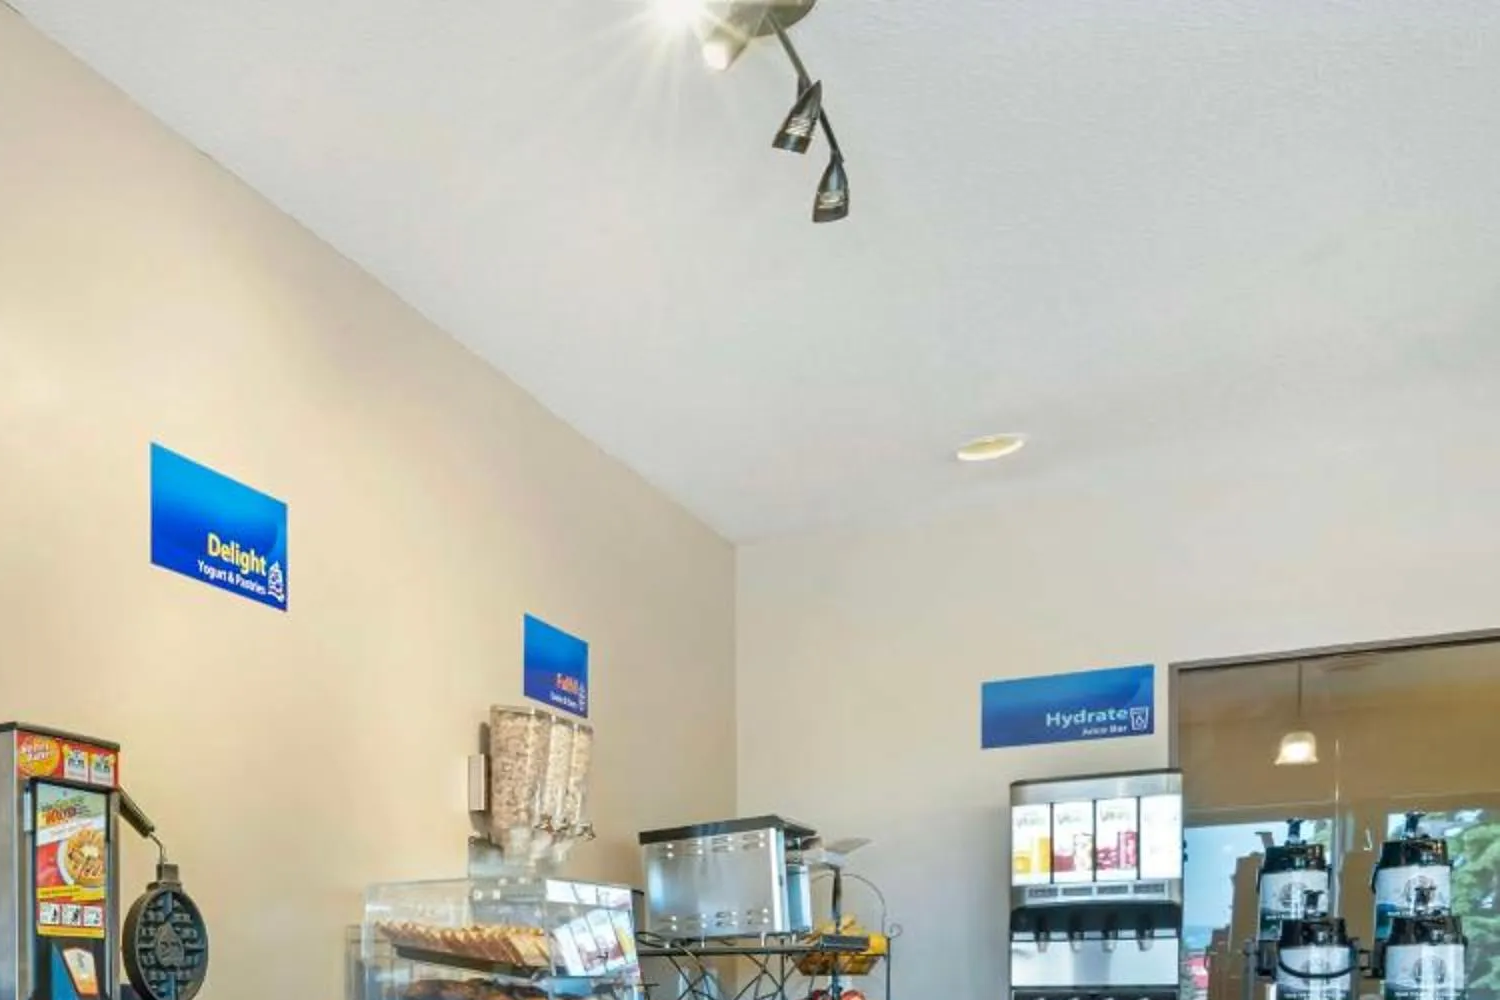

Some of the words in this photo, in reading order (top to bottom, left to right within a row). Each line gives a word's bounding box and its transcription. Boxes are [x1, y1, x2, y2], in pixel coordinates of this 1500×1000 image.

[207, 532, 267, 577] Delight
[197, 559, 227, 582] Yogurt
[227, 570, 235, 585] &
[1045, 707, 1129, 729] Hydrate
